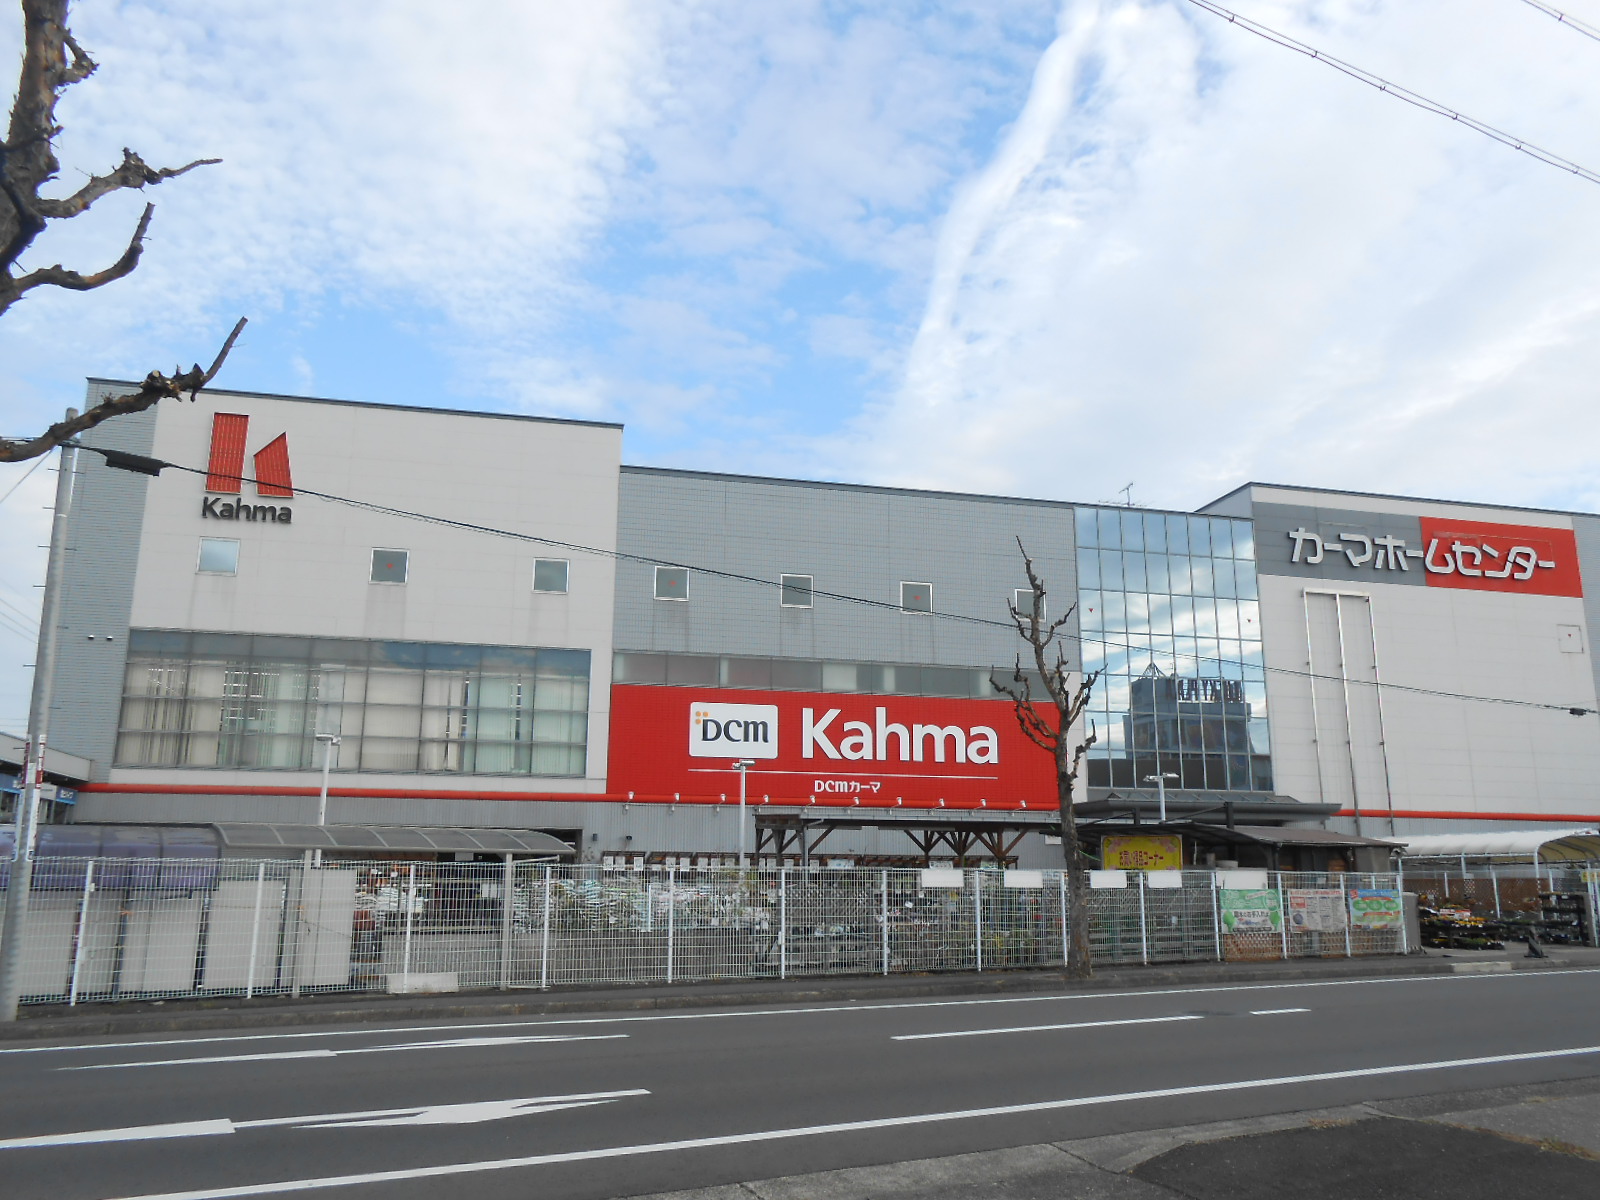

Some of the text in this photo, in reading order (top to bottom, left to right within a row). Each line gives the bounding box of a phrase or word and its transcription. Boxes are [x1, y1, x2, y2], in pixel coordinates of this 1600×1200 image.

[202, 496, 292, 524] Kahma
[1289, 526, 1556, 581] カーマホームセンター
[801, 706, 999, 765] Kahma
